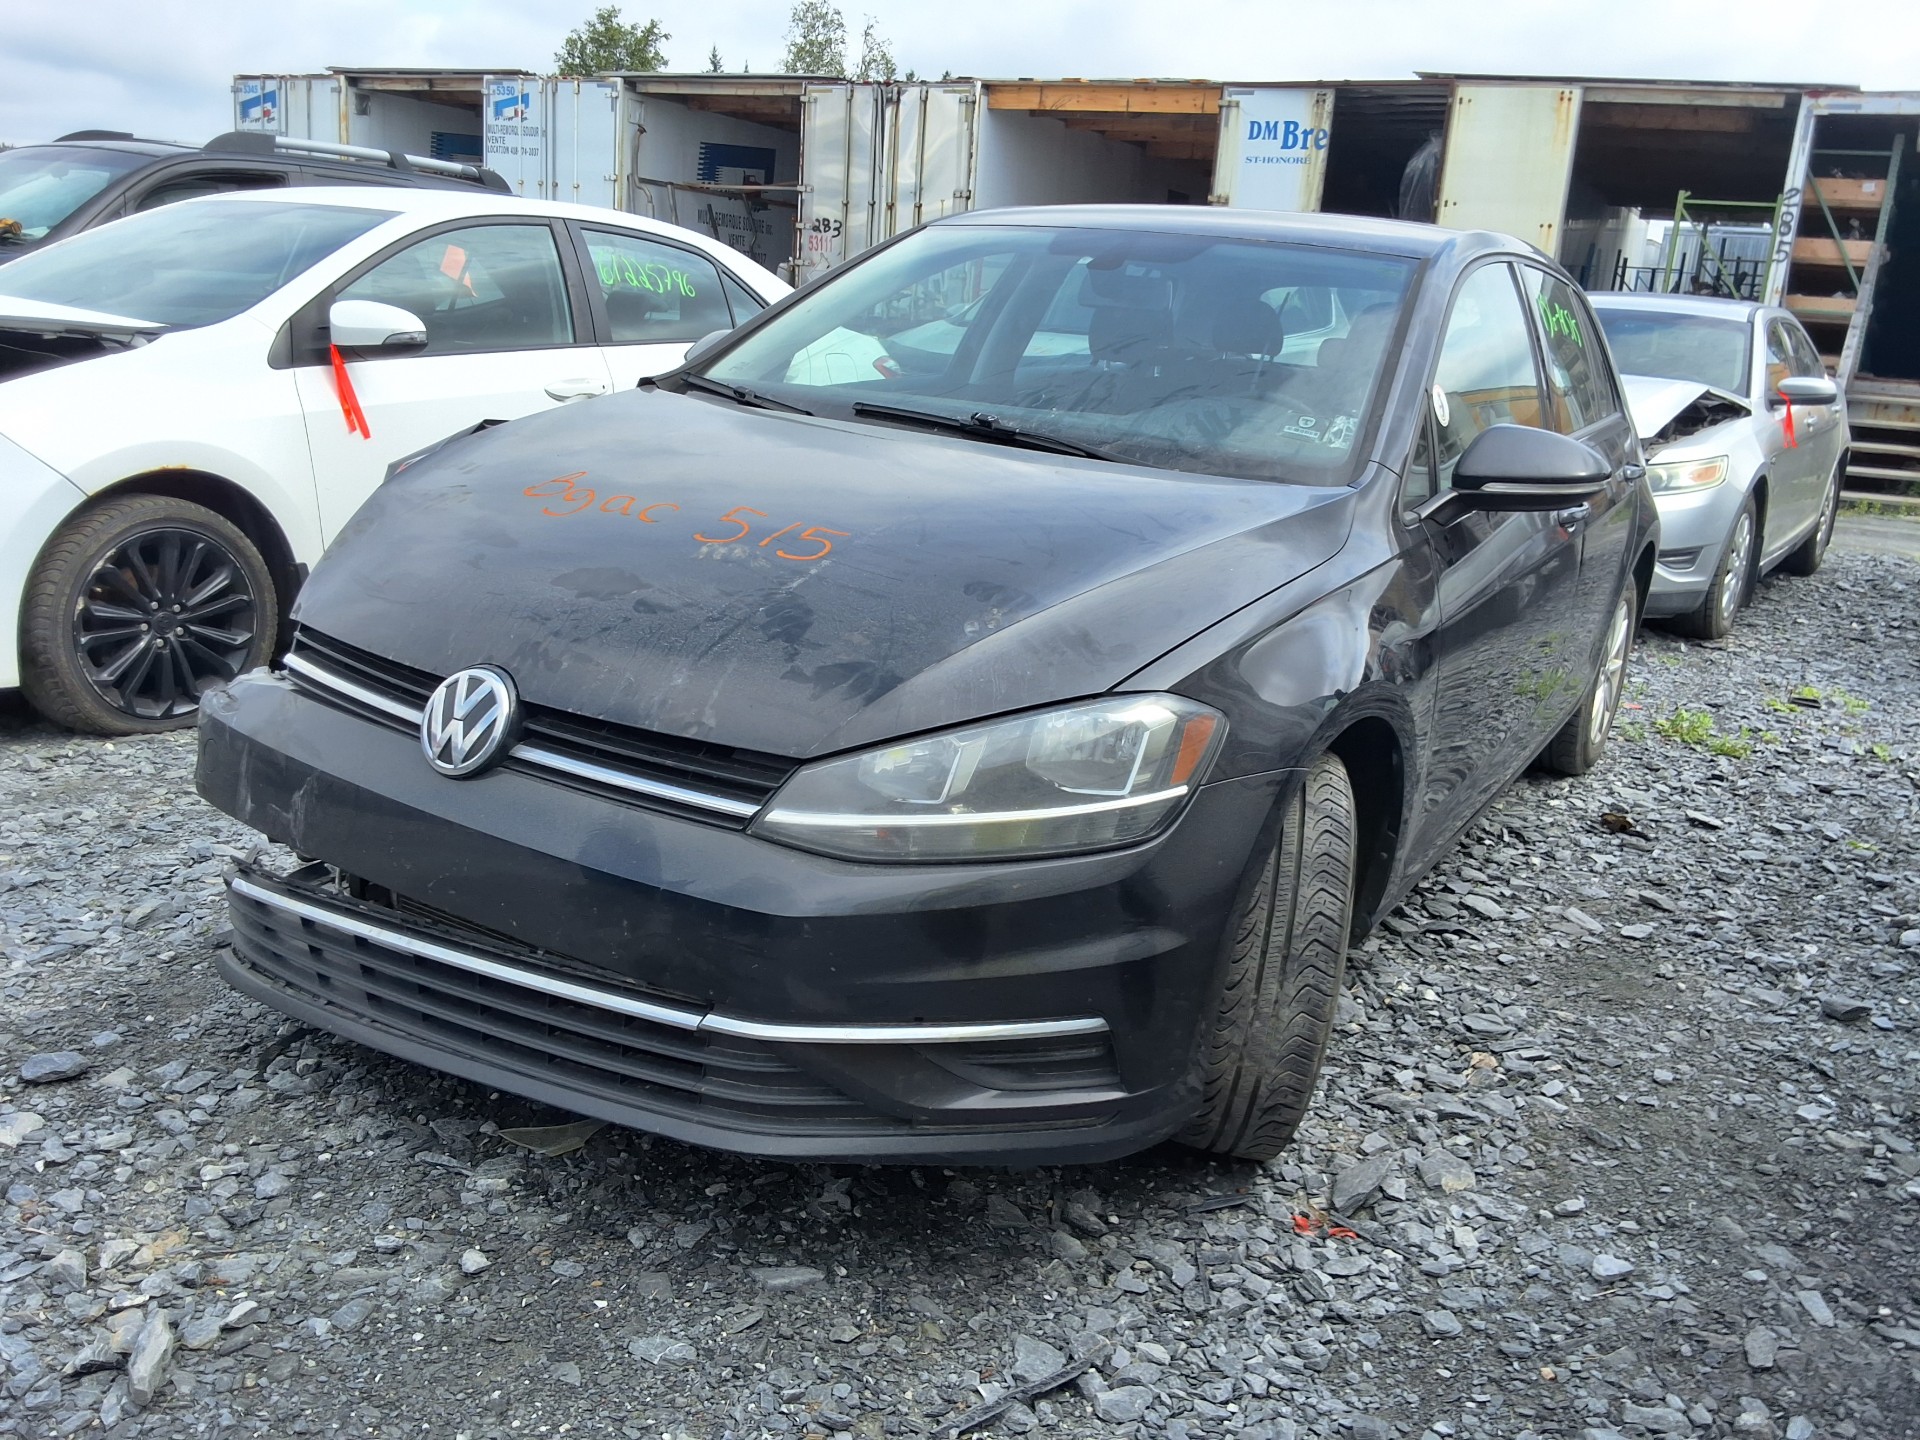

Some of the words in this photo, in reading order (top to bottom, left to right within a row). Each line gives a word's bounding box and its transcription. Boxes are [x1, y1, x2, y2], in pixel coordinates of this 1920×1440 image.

[496, 86, 515, 96] 5350
[487, 136, 506, 145] VENTE
[487, 145, 510, 155] LOCATION
[1244, 153, 1311, 165] ST-HONORÉ
[812, 217, 843, 239] 283
[692, 506, 851, 561] 515
